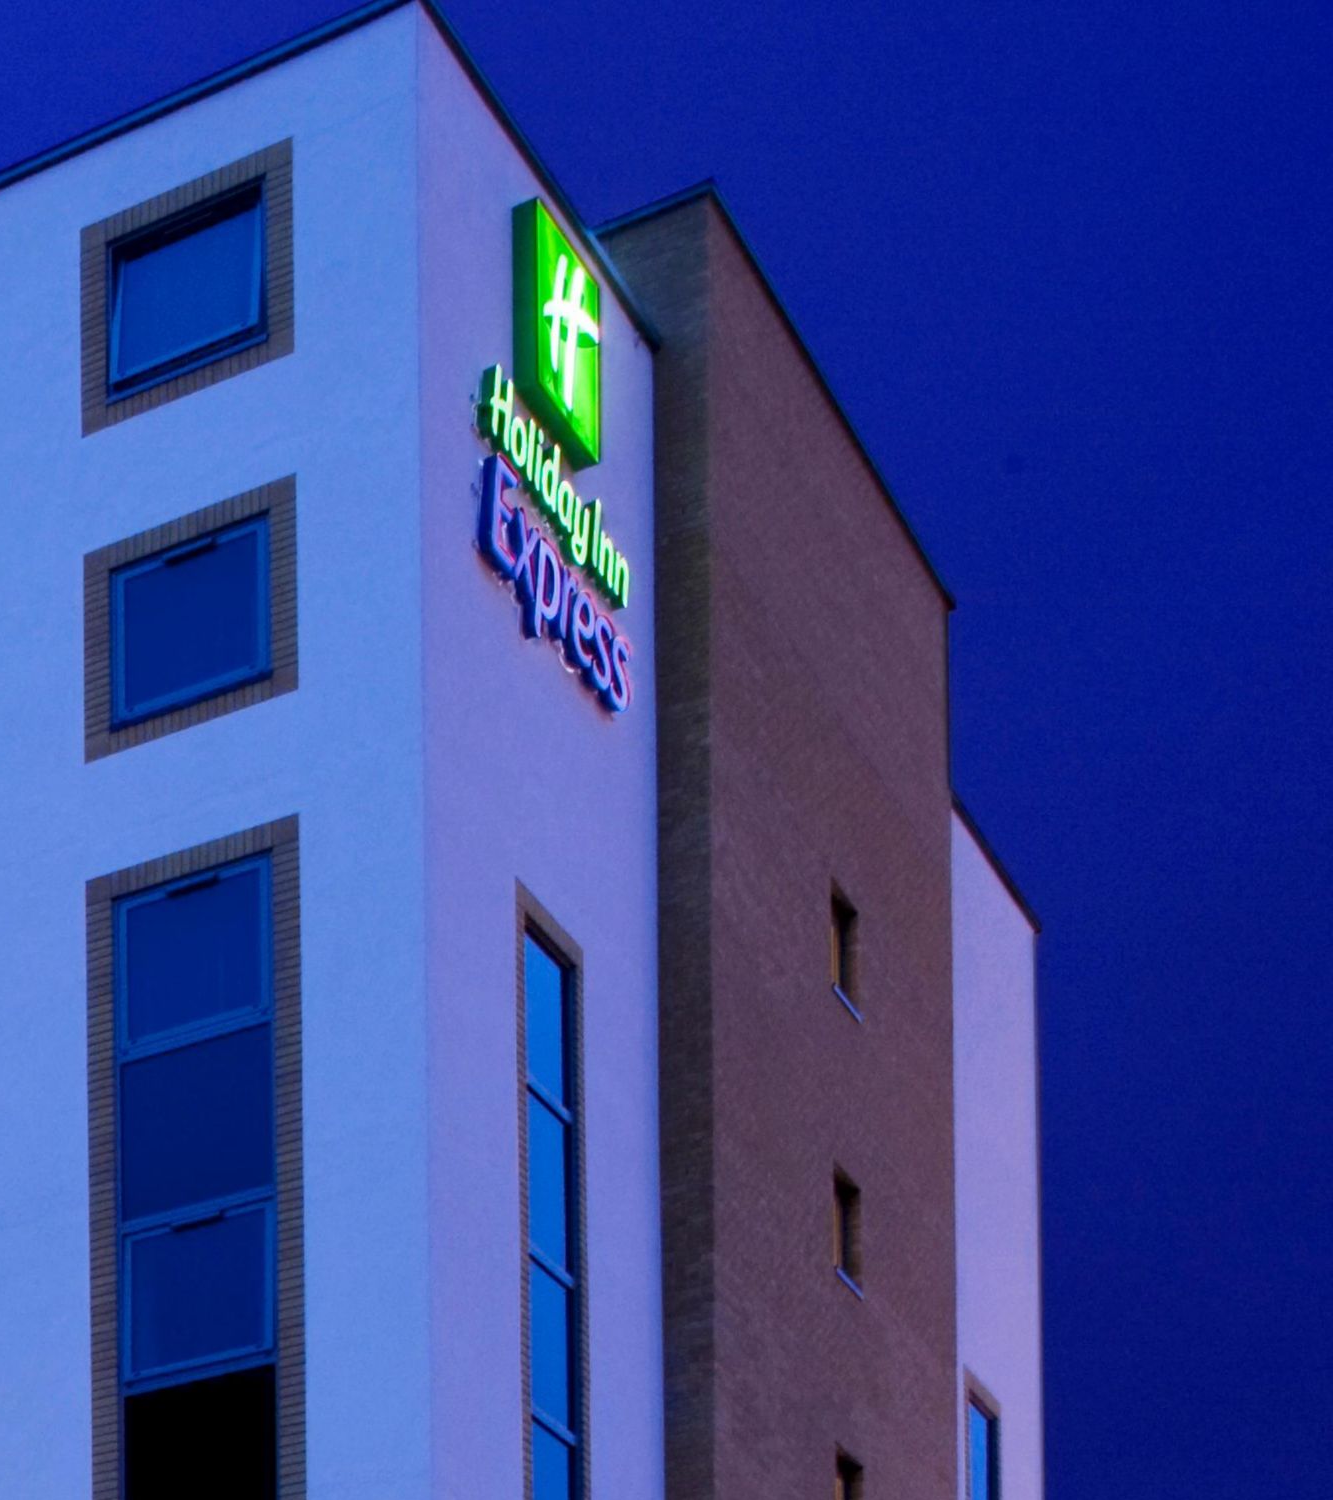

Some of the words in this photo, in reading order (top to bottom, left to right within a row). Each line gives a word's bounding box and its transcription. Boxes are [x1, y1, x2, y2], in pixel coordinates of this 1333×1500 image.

[487, 452, 633, 713] Express
[490, 363, 590, 567] Holiday
[591, 498, 630, 609] Inn
